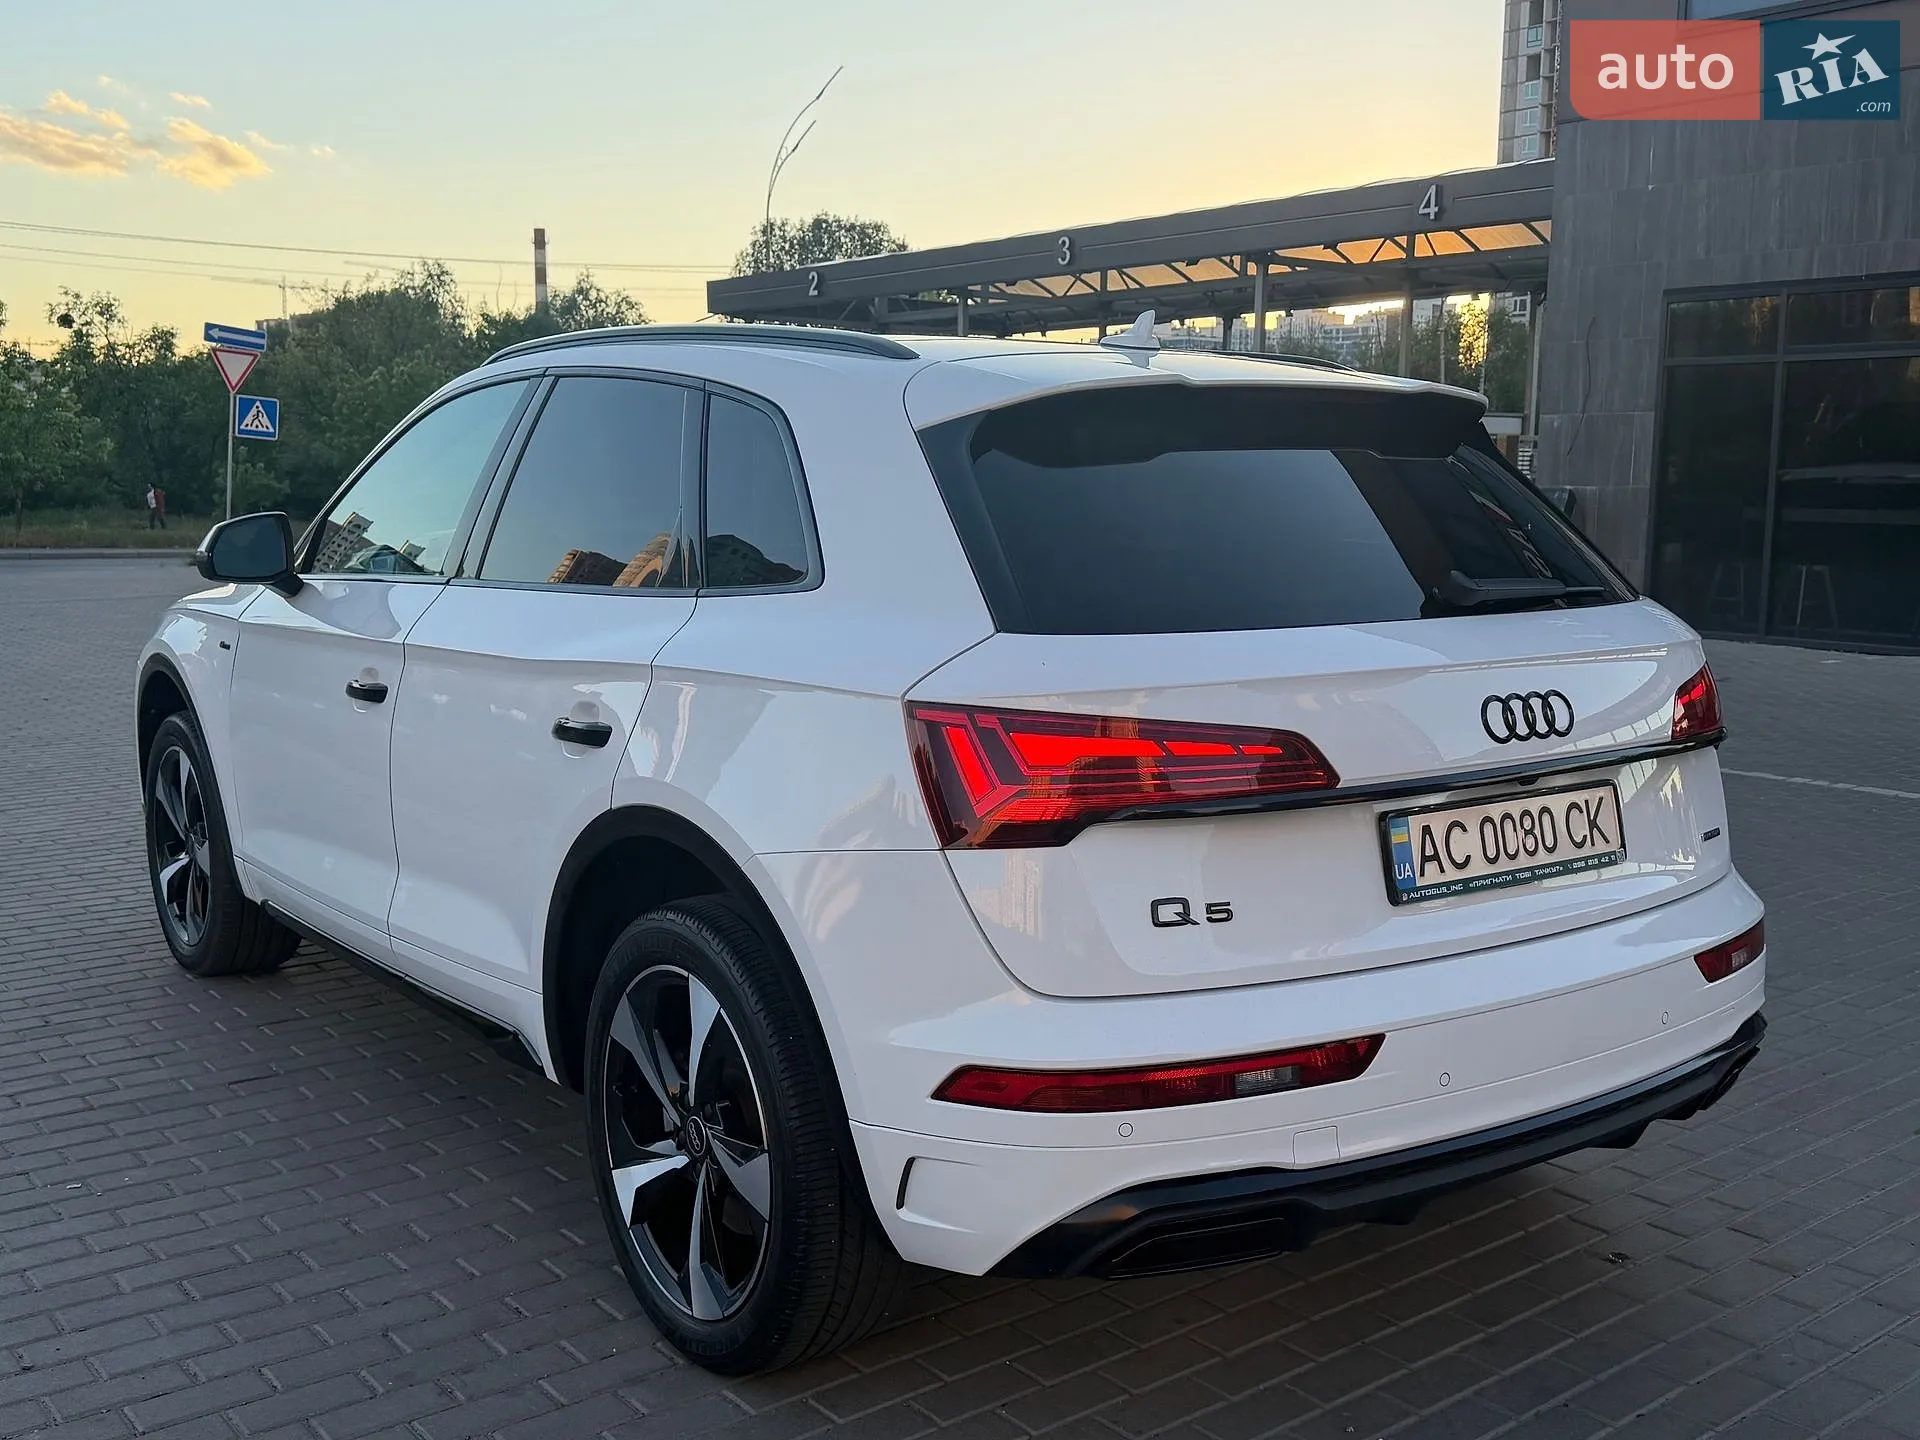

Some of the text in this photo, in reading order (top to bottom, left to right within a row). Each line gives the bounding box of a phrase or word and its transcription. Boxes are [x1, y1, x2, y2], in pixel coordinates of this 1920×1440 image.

[1418, 183, 1439, 220] 4
[1057, 235, 1071, 265] 3
[808, 271, 819, 296] 2
[1418, 795, 1611, 878] AC 0080 CK
[1394, 863, 1414, 880] UA
